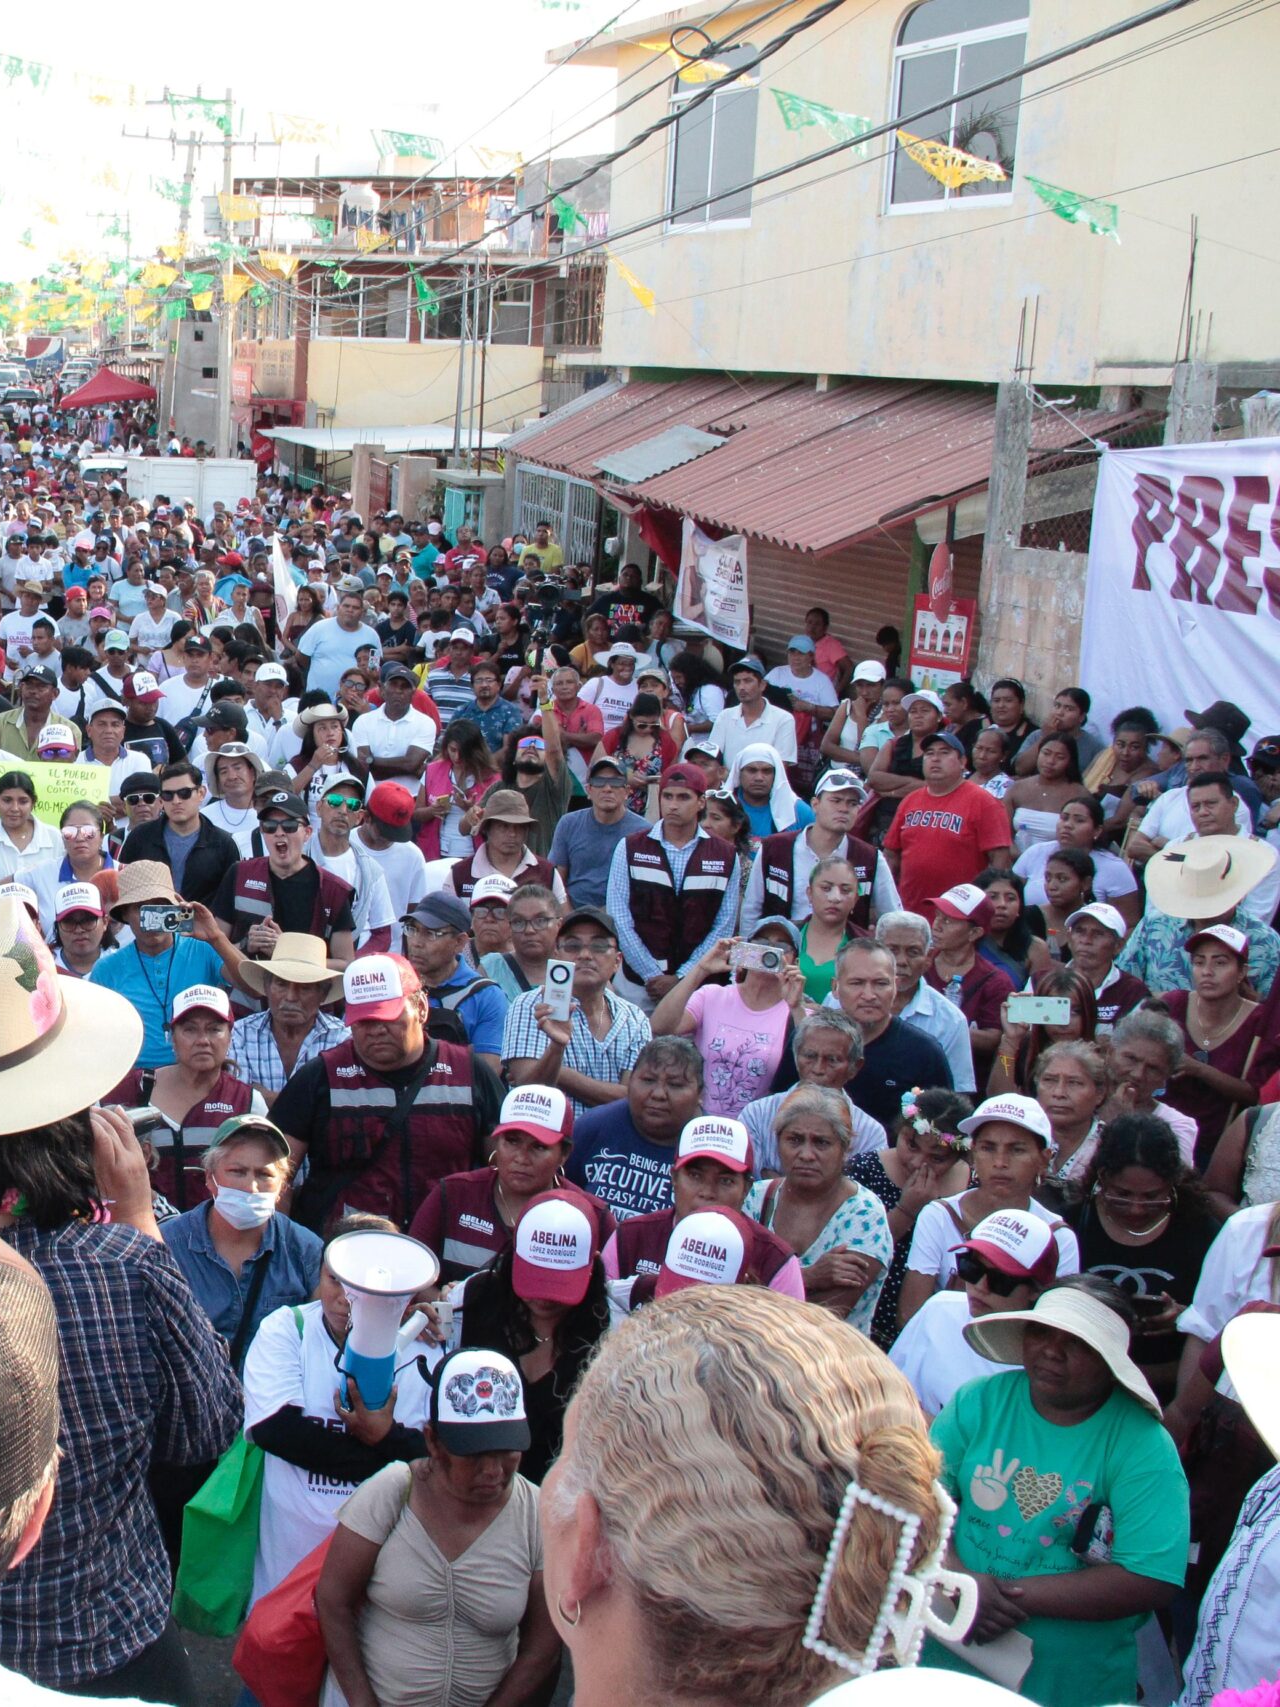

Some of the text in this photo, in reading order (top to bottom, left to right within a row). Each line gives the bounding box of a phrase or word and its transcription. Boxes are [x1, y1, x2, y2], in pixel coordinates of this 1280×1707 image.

[47, 786, 87, 796] CONTIGO
[904, 810, 962, 834] BOSTON
[351, 972, 385, 987] ABELINA
[184, 988, 218, 999] ABELINA
[204, 1102, 233, 1111] morena
[513, 1092, 552, 1108] ABELINA
[692, 1123, 733, 1137] ABELINA
[629, 1153, 658, 1172] BEING
[585, 1162, 671, 1200] EXECUTIVE
[595, 1186, 659, 1212] IS EASY, IT'S
[459, 1213, 494, 1230] ABELINA
[989, 1216, 1029, 1239] ABELINA
[530, 1230, 577, 1247] ABELINA
[546, 1247, 577, 1257] RODRÍGUEZ
[680, 1237, 727, 1262] ABELINA
